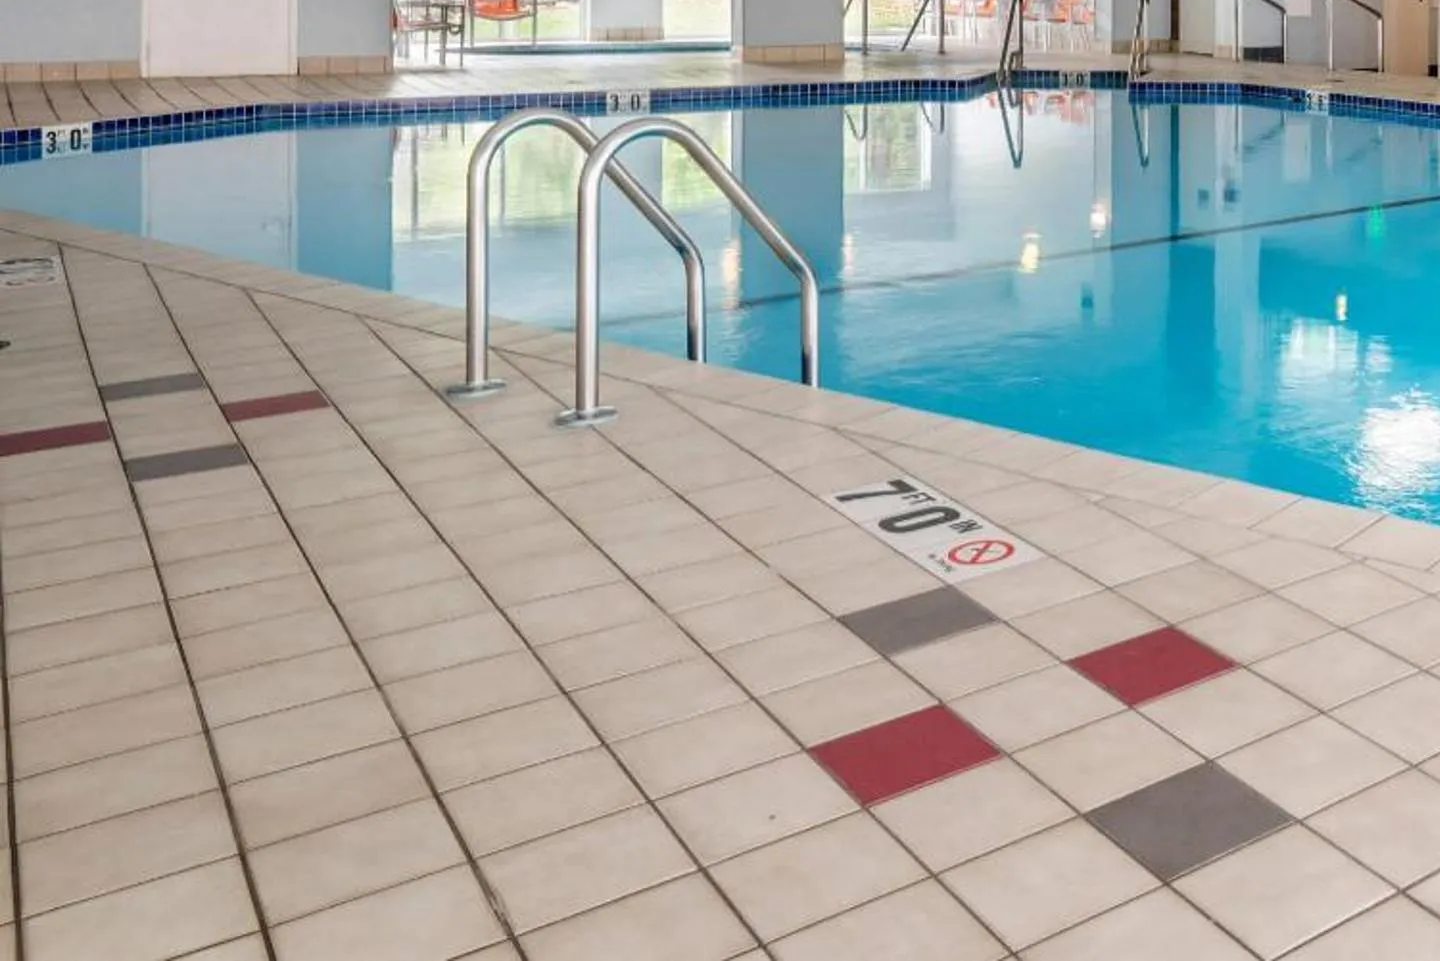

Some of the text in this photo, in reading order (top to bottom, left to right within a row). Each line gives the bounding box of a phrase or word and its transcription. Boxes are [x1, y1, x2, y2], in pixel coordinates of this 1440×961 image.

[70, 128, 82, 150] 0
[834, 479, 919, 502] 7
[902, 491, 937, 505] FT
[878, 505, 961, 534] 0
